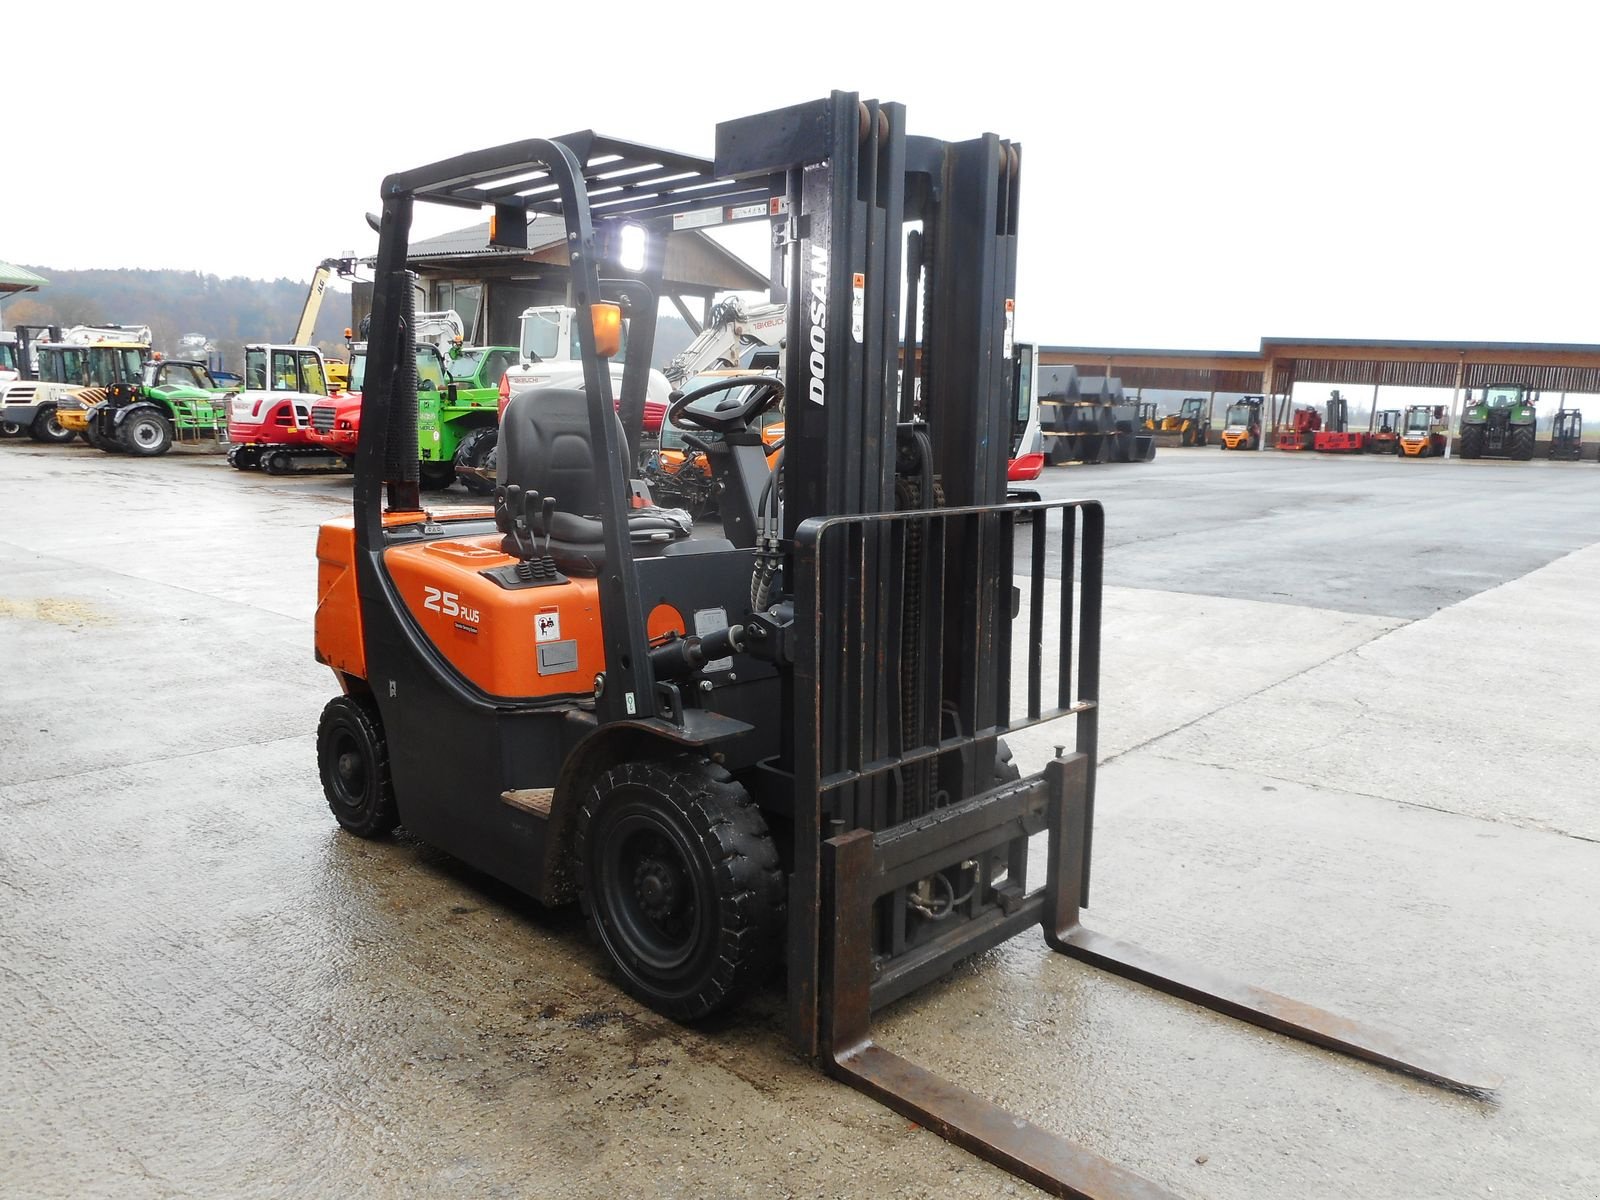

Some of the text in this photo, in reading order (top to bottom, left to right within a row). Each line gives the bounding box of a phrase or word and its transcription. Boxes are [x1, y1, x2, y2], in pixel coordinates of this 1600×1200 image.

[317, 279, 325, 296] JLG
[809, 244, 828, 406] DOOSAN
[424, 585, 480, 624] 25 PLUS
